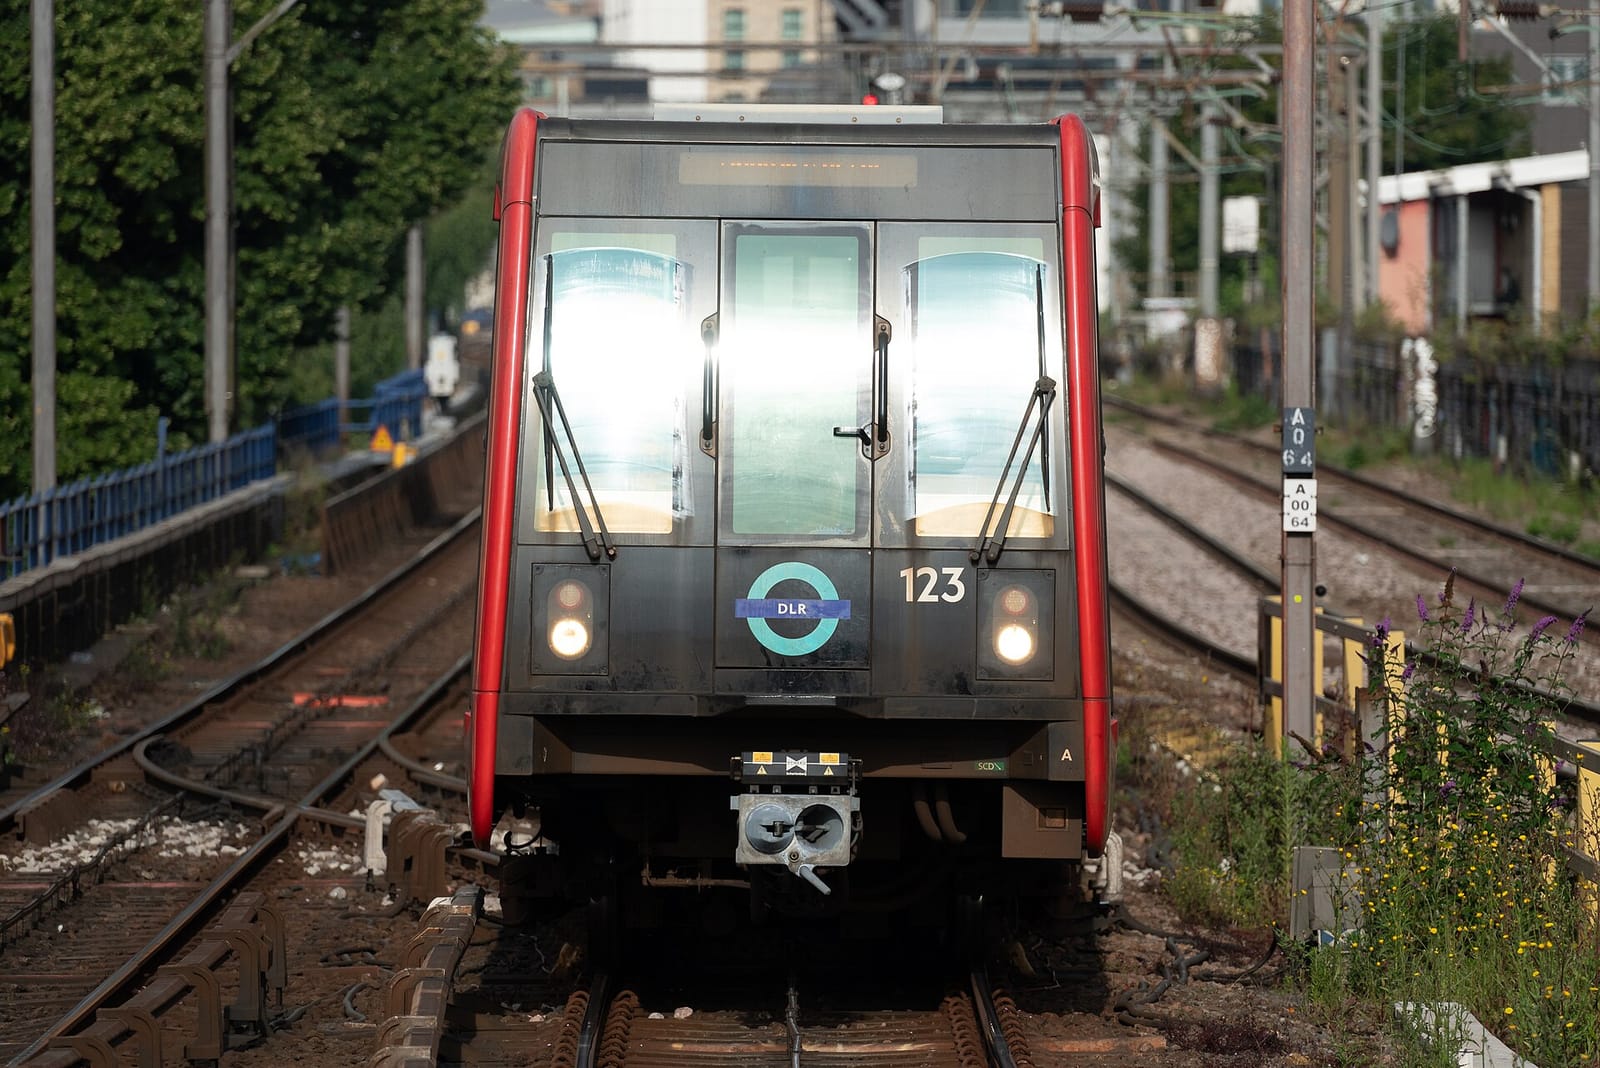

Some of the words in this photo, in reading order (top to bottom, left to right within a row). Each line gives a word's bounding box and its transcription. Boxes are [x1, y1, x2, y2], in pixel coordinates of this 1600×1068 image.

[1291, 408, 1305, 425] A
[1295, 484, 1306, 494] A
[1291, 500, 1309, 511] 00
[1291, 517, 1309, 527] 64
[900, 567, 965, 603] 123
[778, 603, 807, 615] DLR
[1061, 748, 1073, 761] A
